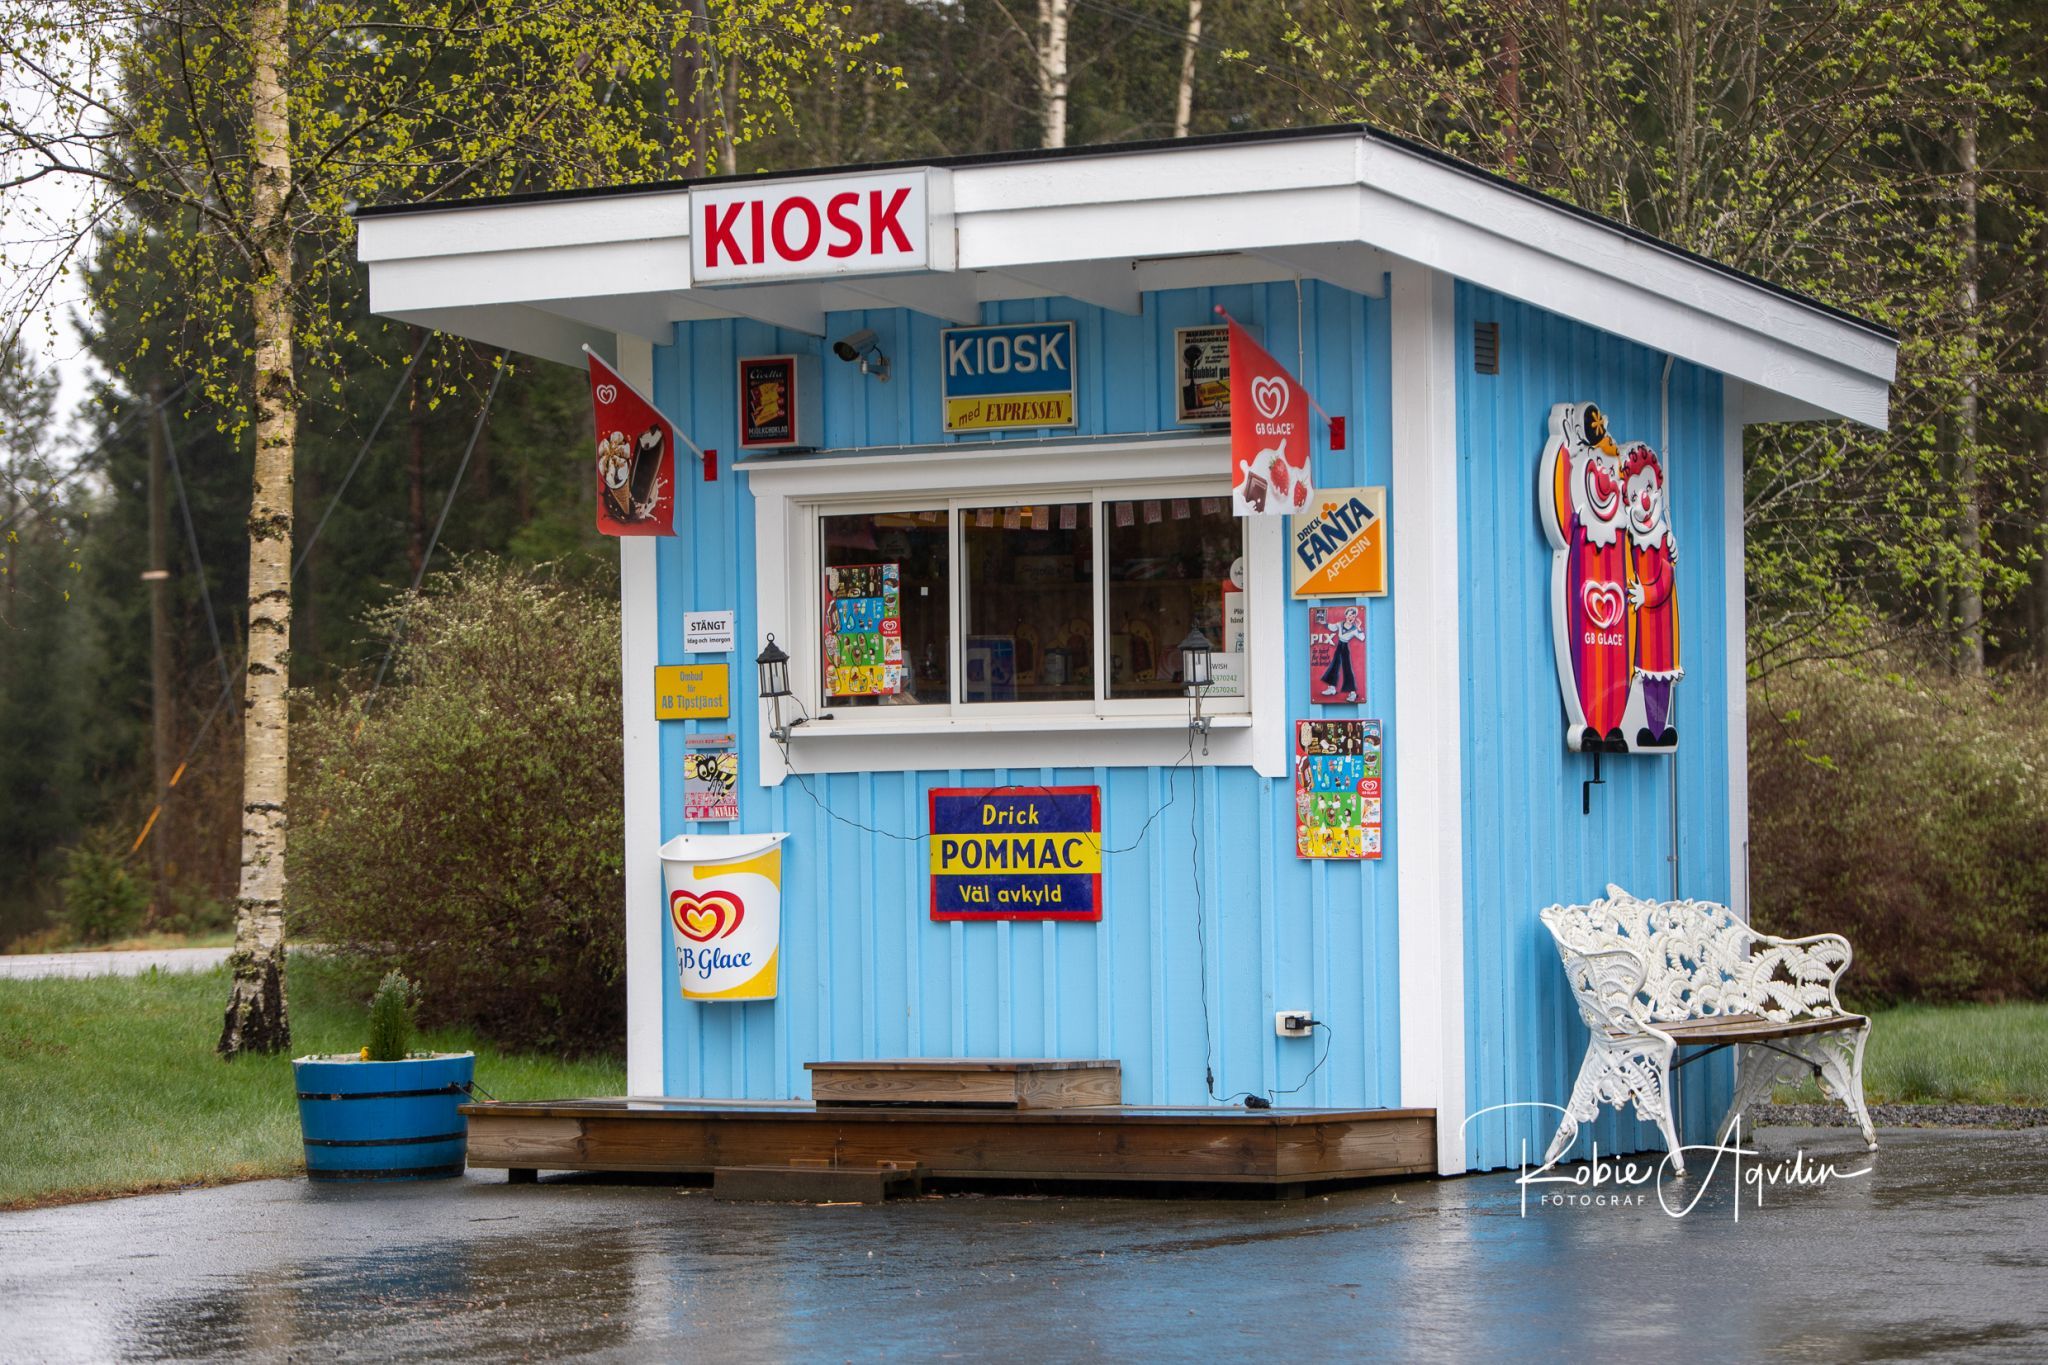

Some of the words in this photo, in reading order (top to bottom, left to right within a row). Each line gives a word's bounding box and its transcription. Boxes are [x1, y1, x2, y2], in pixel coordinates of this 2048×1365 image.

[705, 187, 914, 268] KIOSK
[950, 332, 1068, 377] KIOSK
[959, 400, 981, 427] med
[985, 400, 1064, 422] EXPRESSEN
[1256, 423, 1266, 435] GB
[1268, 422, 1292, 435] GLACE
[1297, 517, 1322, 541] DRICK
[1297, 497, 1375, 572] FANTA
[1326, 536, 1373, 581] APELSIN
[691, 620, 726, 631] STÄNGT
[1311, 633, 1337, 646] PIX
[1584, 632, 1596, 645] GB
[1597, 632, 1622, 647] GLACE
[680, 670, 704, 681] Ombud
[1211, 674, 1237, 682] 5370242
[687, 684, 696, 693] för
[662, 695, 674, 709] AB
[676, 694, 723, 711] Tipstjänst
[982, 803, 1040, 826] Drick
[942, 838, 1084, 870] POMMAC
[959, 885, 990, 903] Väl
[997, 884, 1063, 906] avkyld
[699, 947, 752, 980] Glace
